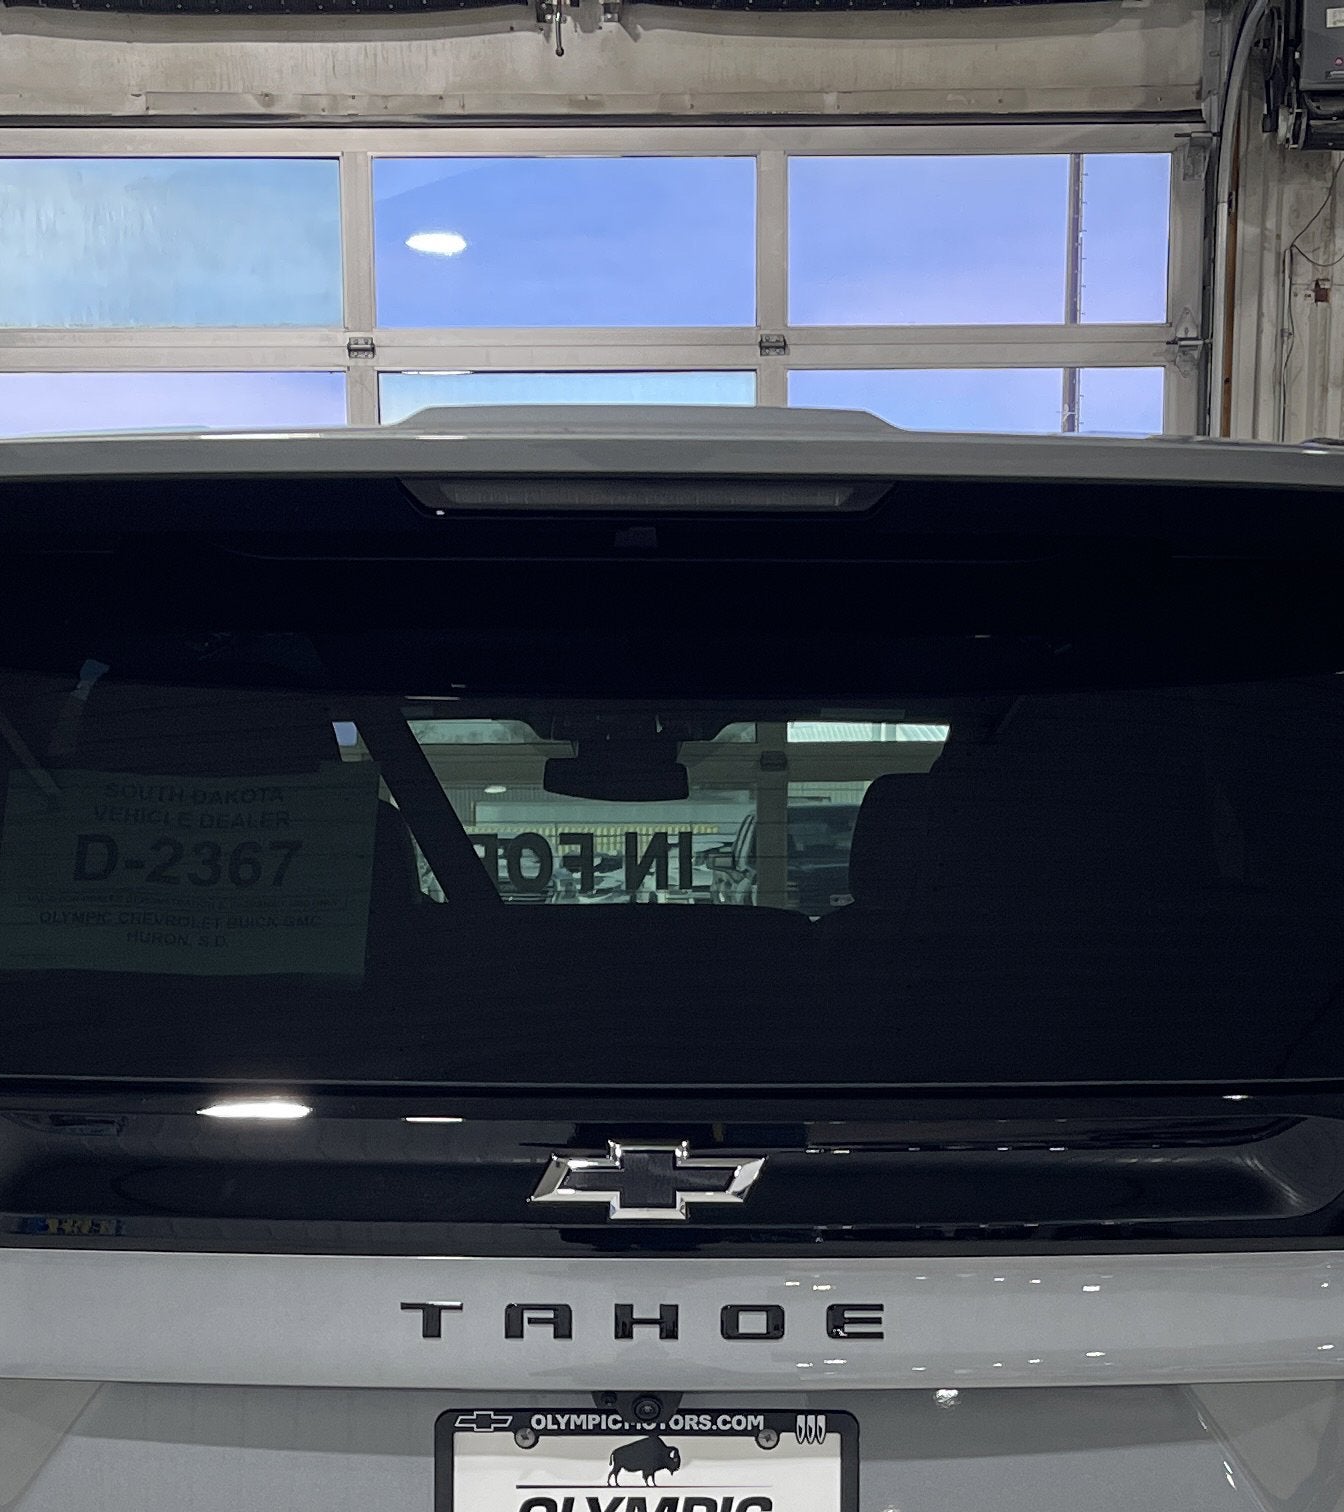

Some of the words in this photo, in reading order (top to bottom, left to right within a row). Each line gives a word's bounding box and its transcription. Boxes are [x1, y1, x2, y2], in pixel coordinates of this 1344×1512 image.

[104, 783, 184, 803] SOUTH
[192, 787, 284, 805] DAKOTA
[94, 806, 191, 827] VEHICLE
[199, 810, 290, 829] DEALER
[73, 833, 303, 888] D-2367
[400, 1301, 884, 1340] TAHOE
[531, 1414, 764, 1430] OLYMPICORS.COM
